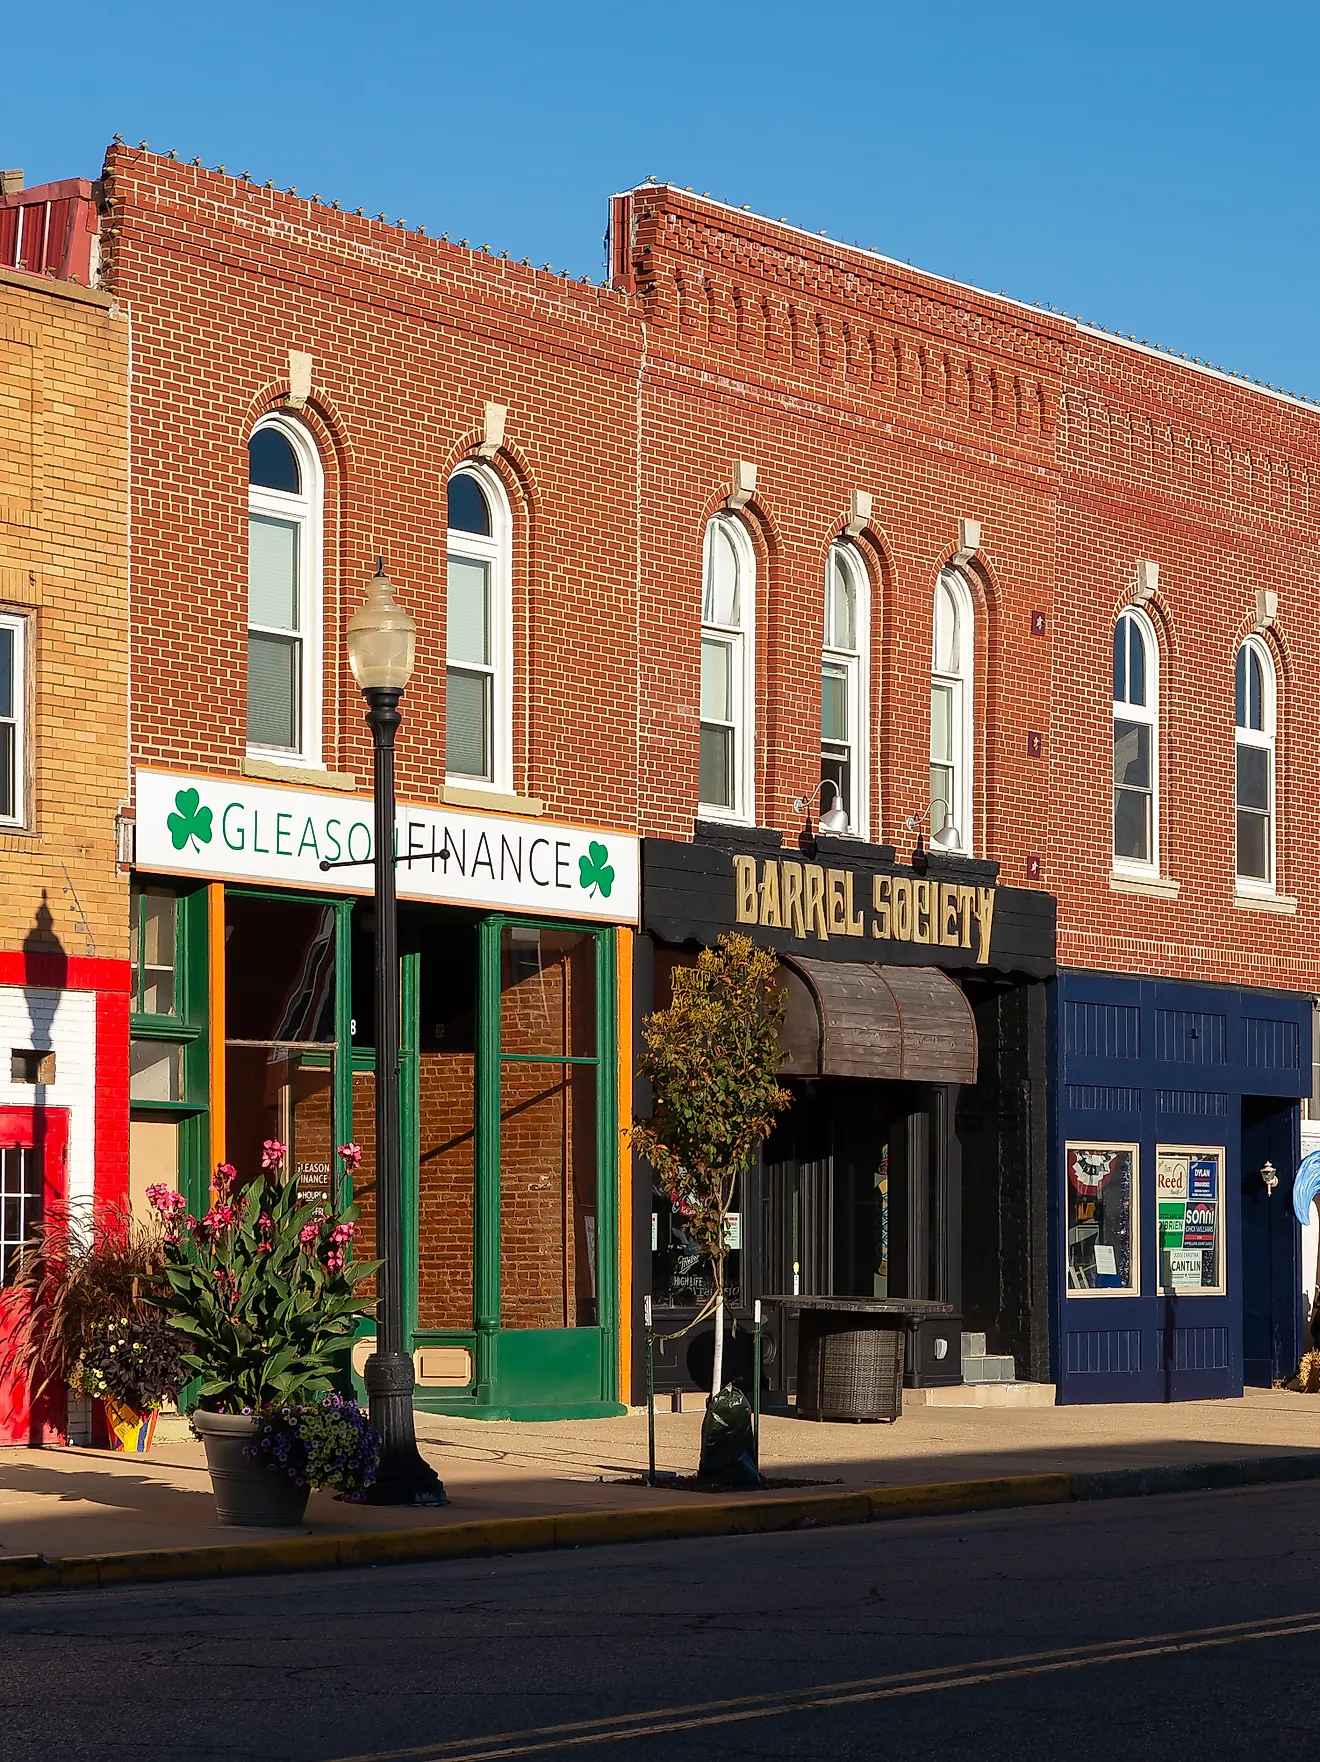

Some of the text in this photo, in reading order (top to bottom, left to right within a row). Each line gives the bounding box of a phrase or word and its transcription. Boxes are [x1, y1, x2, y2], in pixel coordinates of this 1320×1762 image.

[408, 821, 572, 889] FINANCE
[732, 854, 997, 964] BARREL SOCIETY
[1194, 1168, 1211, 1177] DYLAN
[300, 1174, 328, 1184] INANCE
[1158, 1170, 1183, 1189] Reed
[1172, 1261, 1201, 1271] CANTLIN
[674, 1276, 703, 1287] HIGH LIFE
